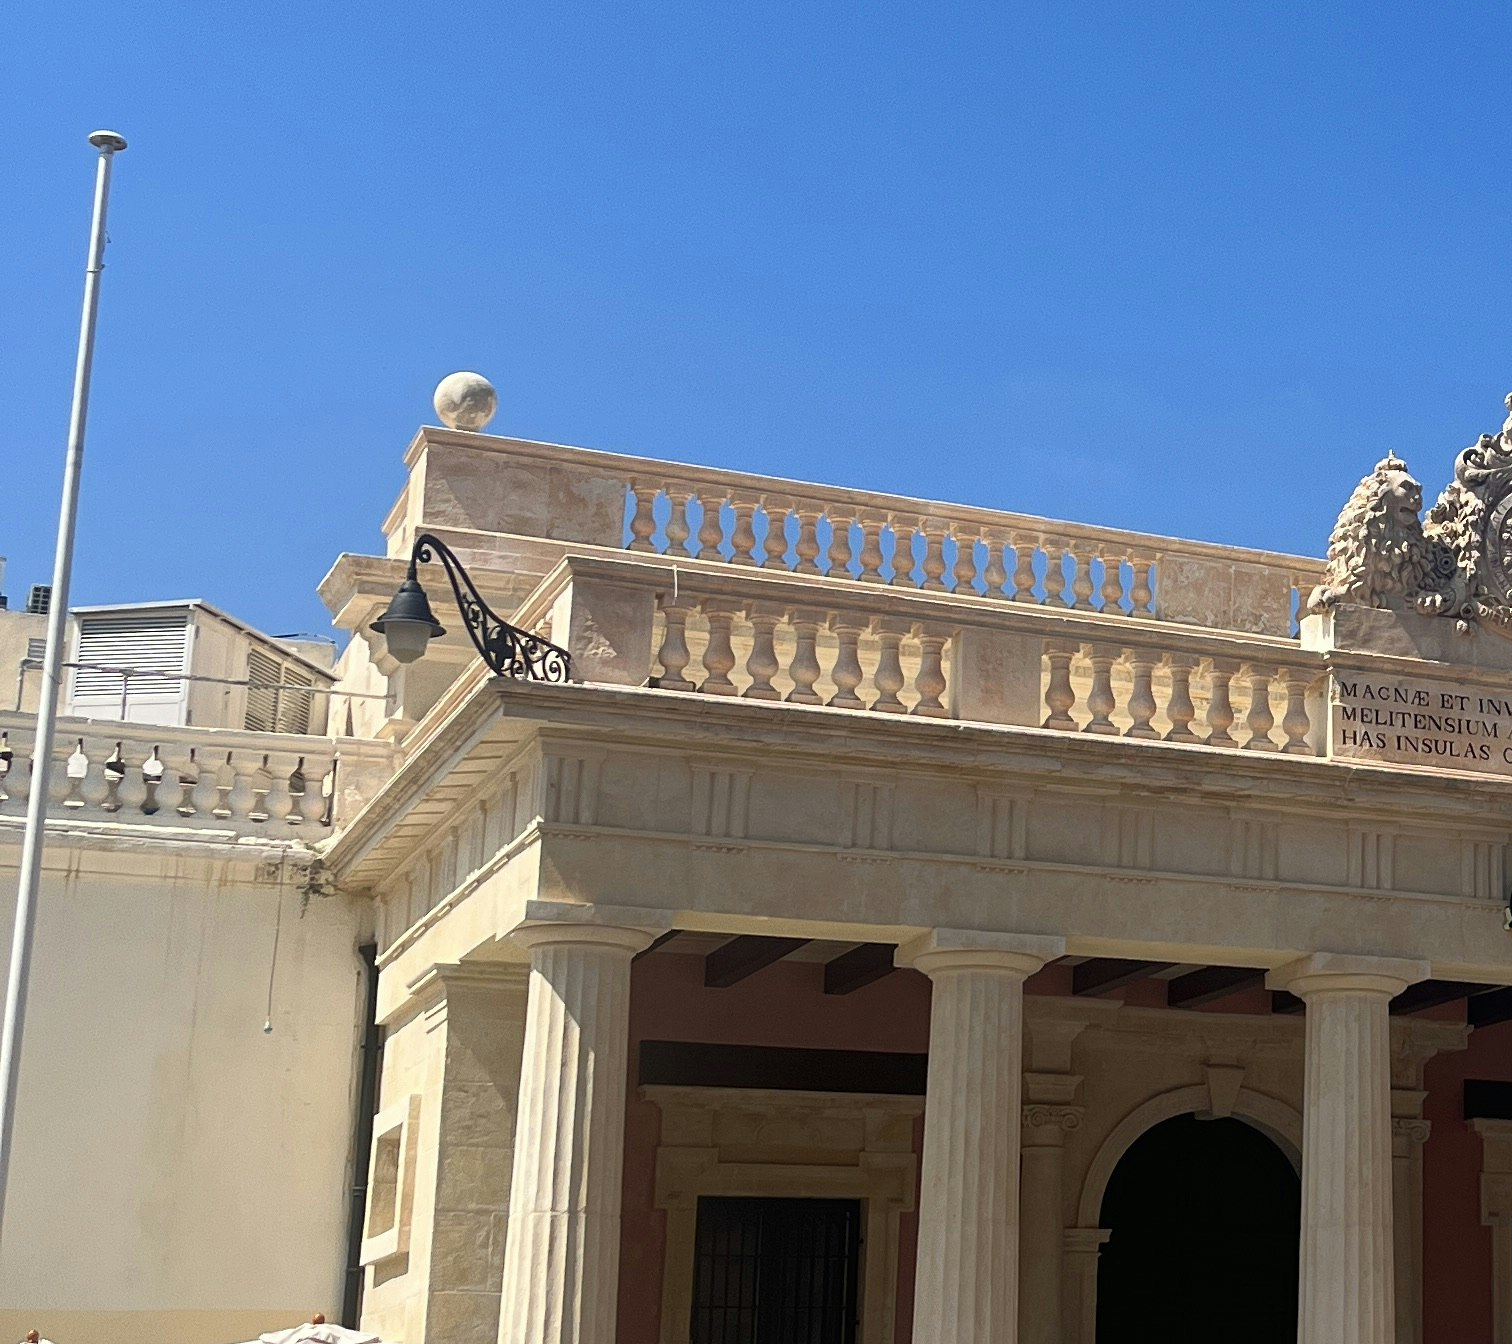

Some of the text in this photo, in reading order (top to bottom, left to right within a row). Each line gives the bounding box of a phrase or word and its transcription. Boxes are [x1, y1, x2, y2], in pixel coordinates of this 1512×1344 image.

[1440, 693, 1470, 711] ET
[1342, 706, 1499, 739] MELITENSIUM
[1342, 729, 1387, 749] HAS
[1396, 735, 1491, 761] INSULAS
